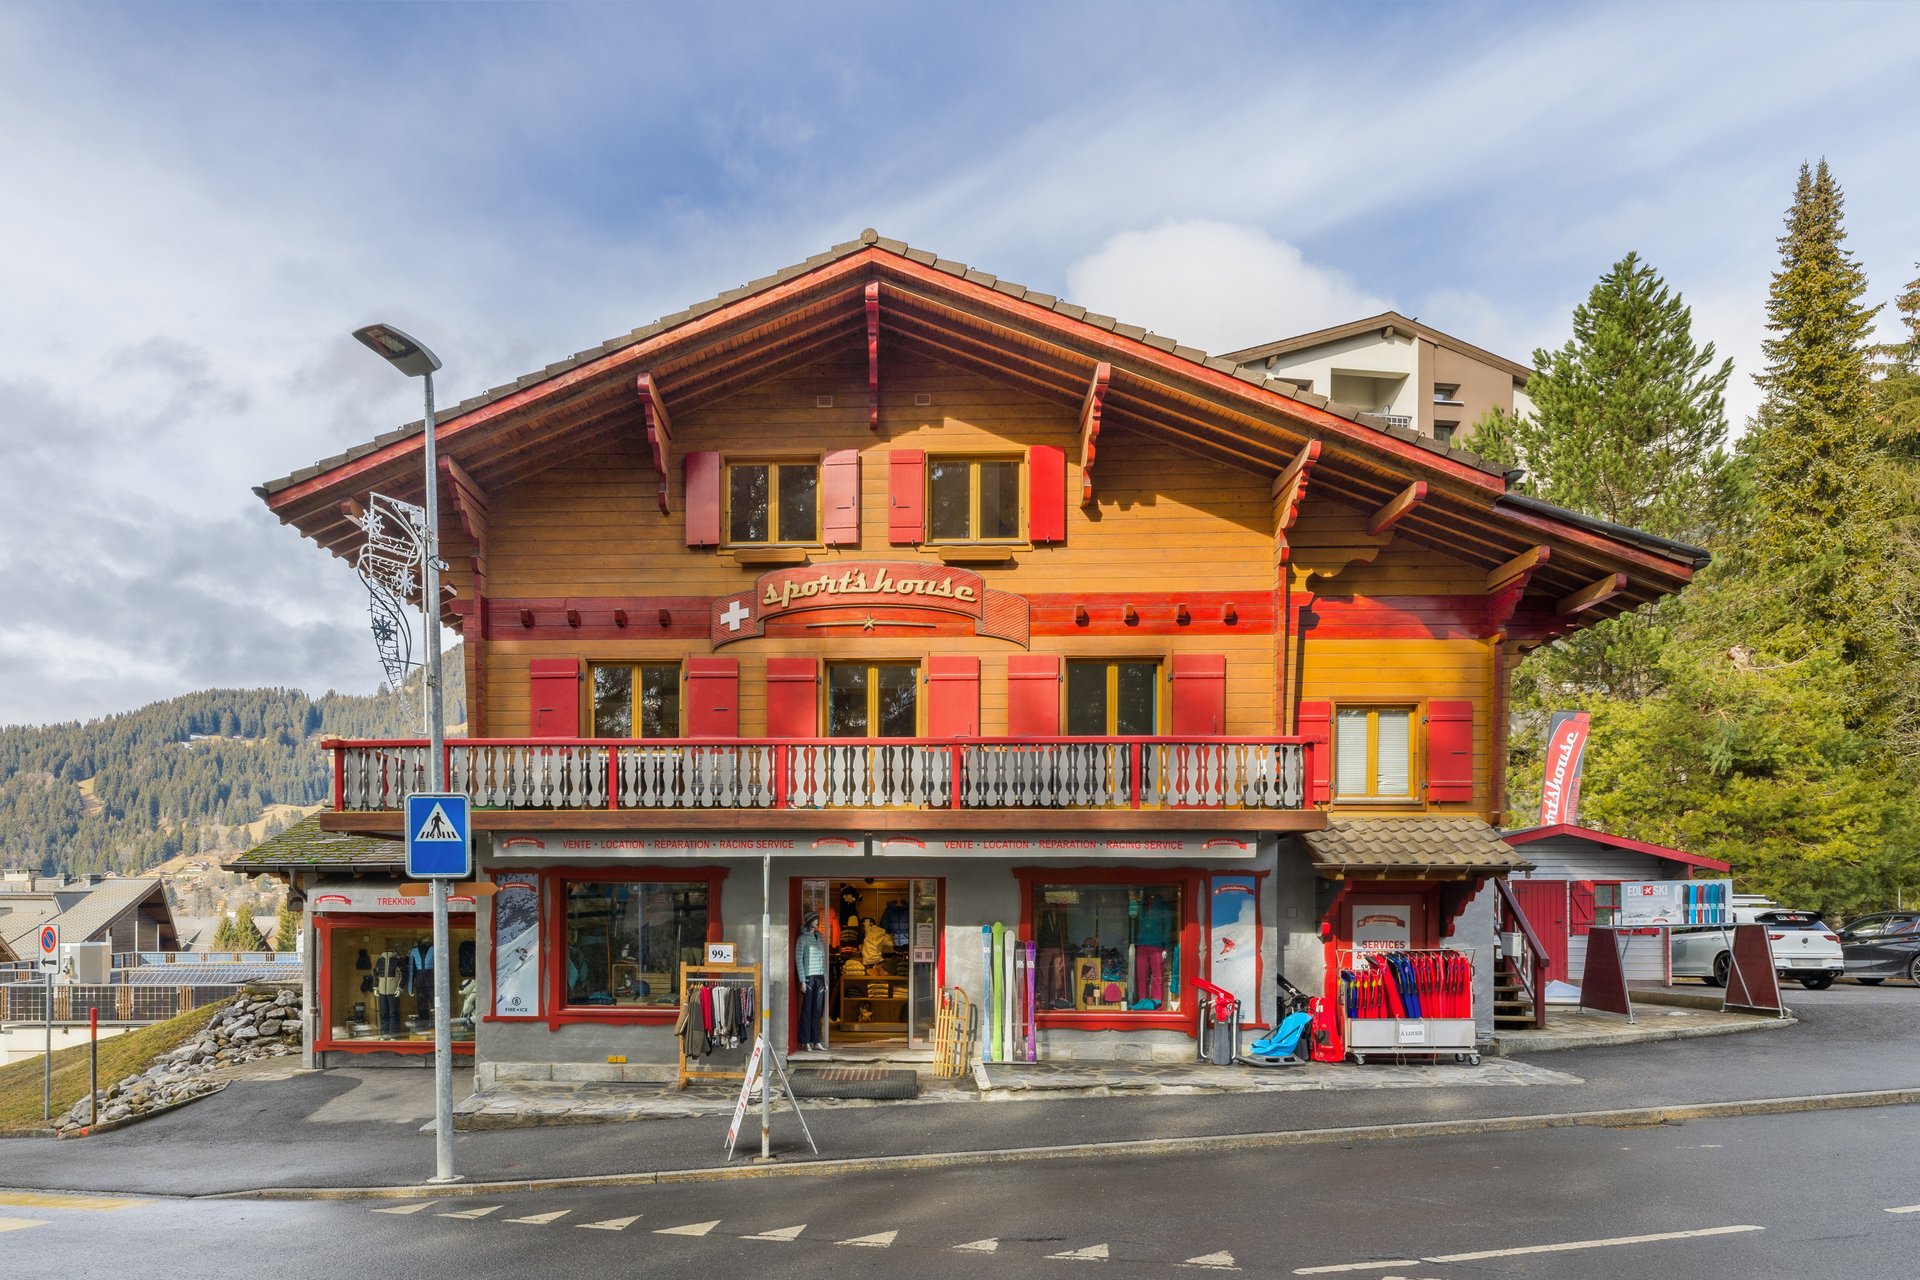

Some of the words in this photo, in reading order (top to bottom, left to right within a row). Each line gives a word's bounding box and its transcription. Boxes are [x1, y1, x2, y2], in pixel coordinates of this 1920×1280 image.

[562, 840, 591, 849] VENTE
[600, 840, 645, 849] LOCATION
[719, 840, 754, 849] RACING
[756, 840, 794, 849] SERVICE
[943, 840, 973, 849] VENTE
[983, 840, 1029, 849] LOCATION
[1105, 840, 1142, 849] RACING
[1143, 841, 1183, 850] SERVICE
[377, 897, 416, 906] TREKKING
[1362, 940, 1406, 949] SERVICES
[711, 949, 731, 959] 99.-
